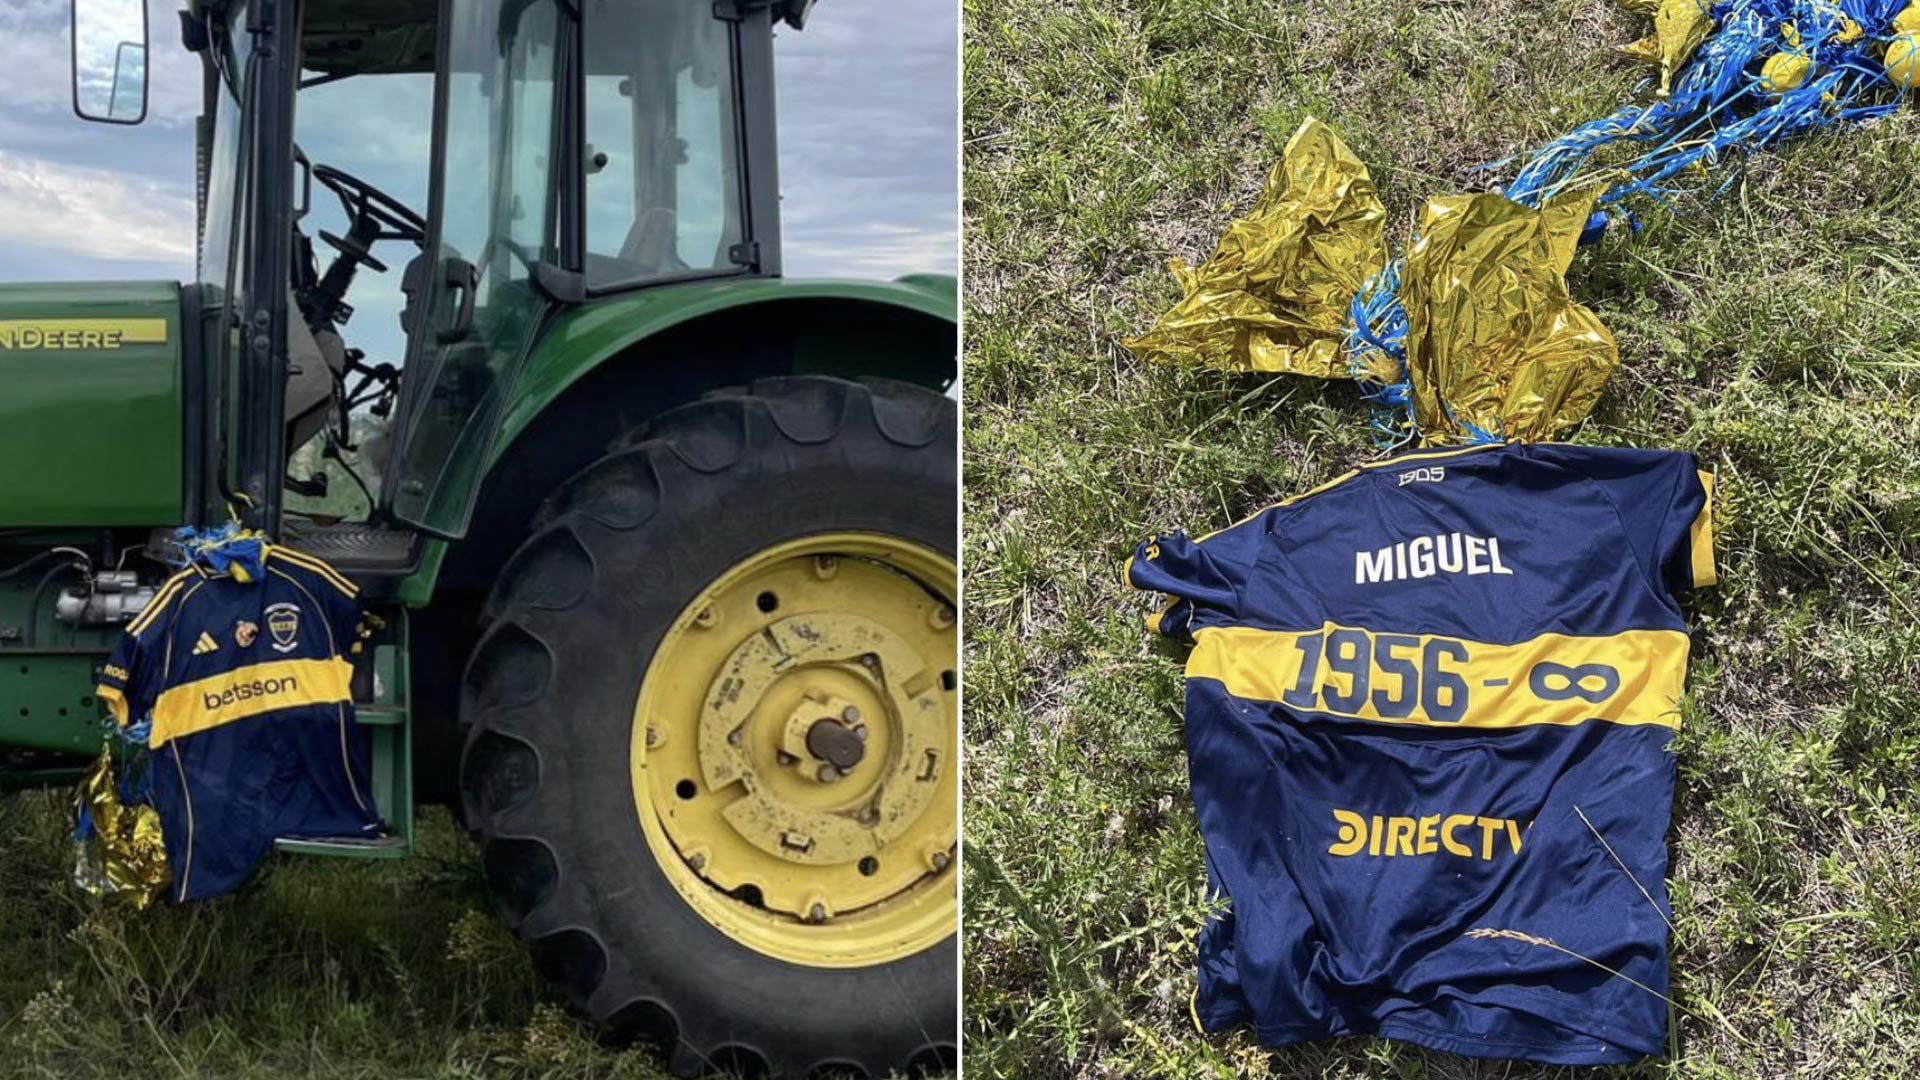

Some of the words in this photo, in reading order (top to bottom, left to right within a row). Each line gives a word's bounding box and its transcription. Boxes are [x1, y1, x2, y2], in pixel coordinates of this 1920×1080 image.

[19, 327, 121, 350] DEERE
[1398, 466, 1445, 487] 1905
[1355, 532, 1514, 584] MIGUEL
[203, 676, 297, 710] betsson
[1283, 629, 1469, 723] 1956
